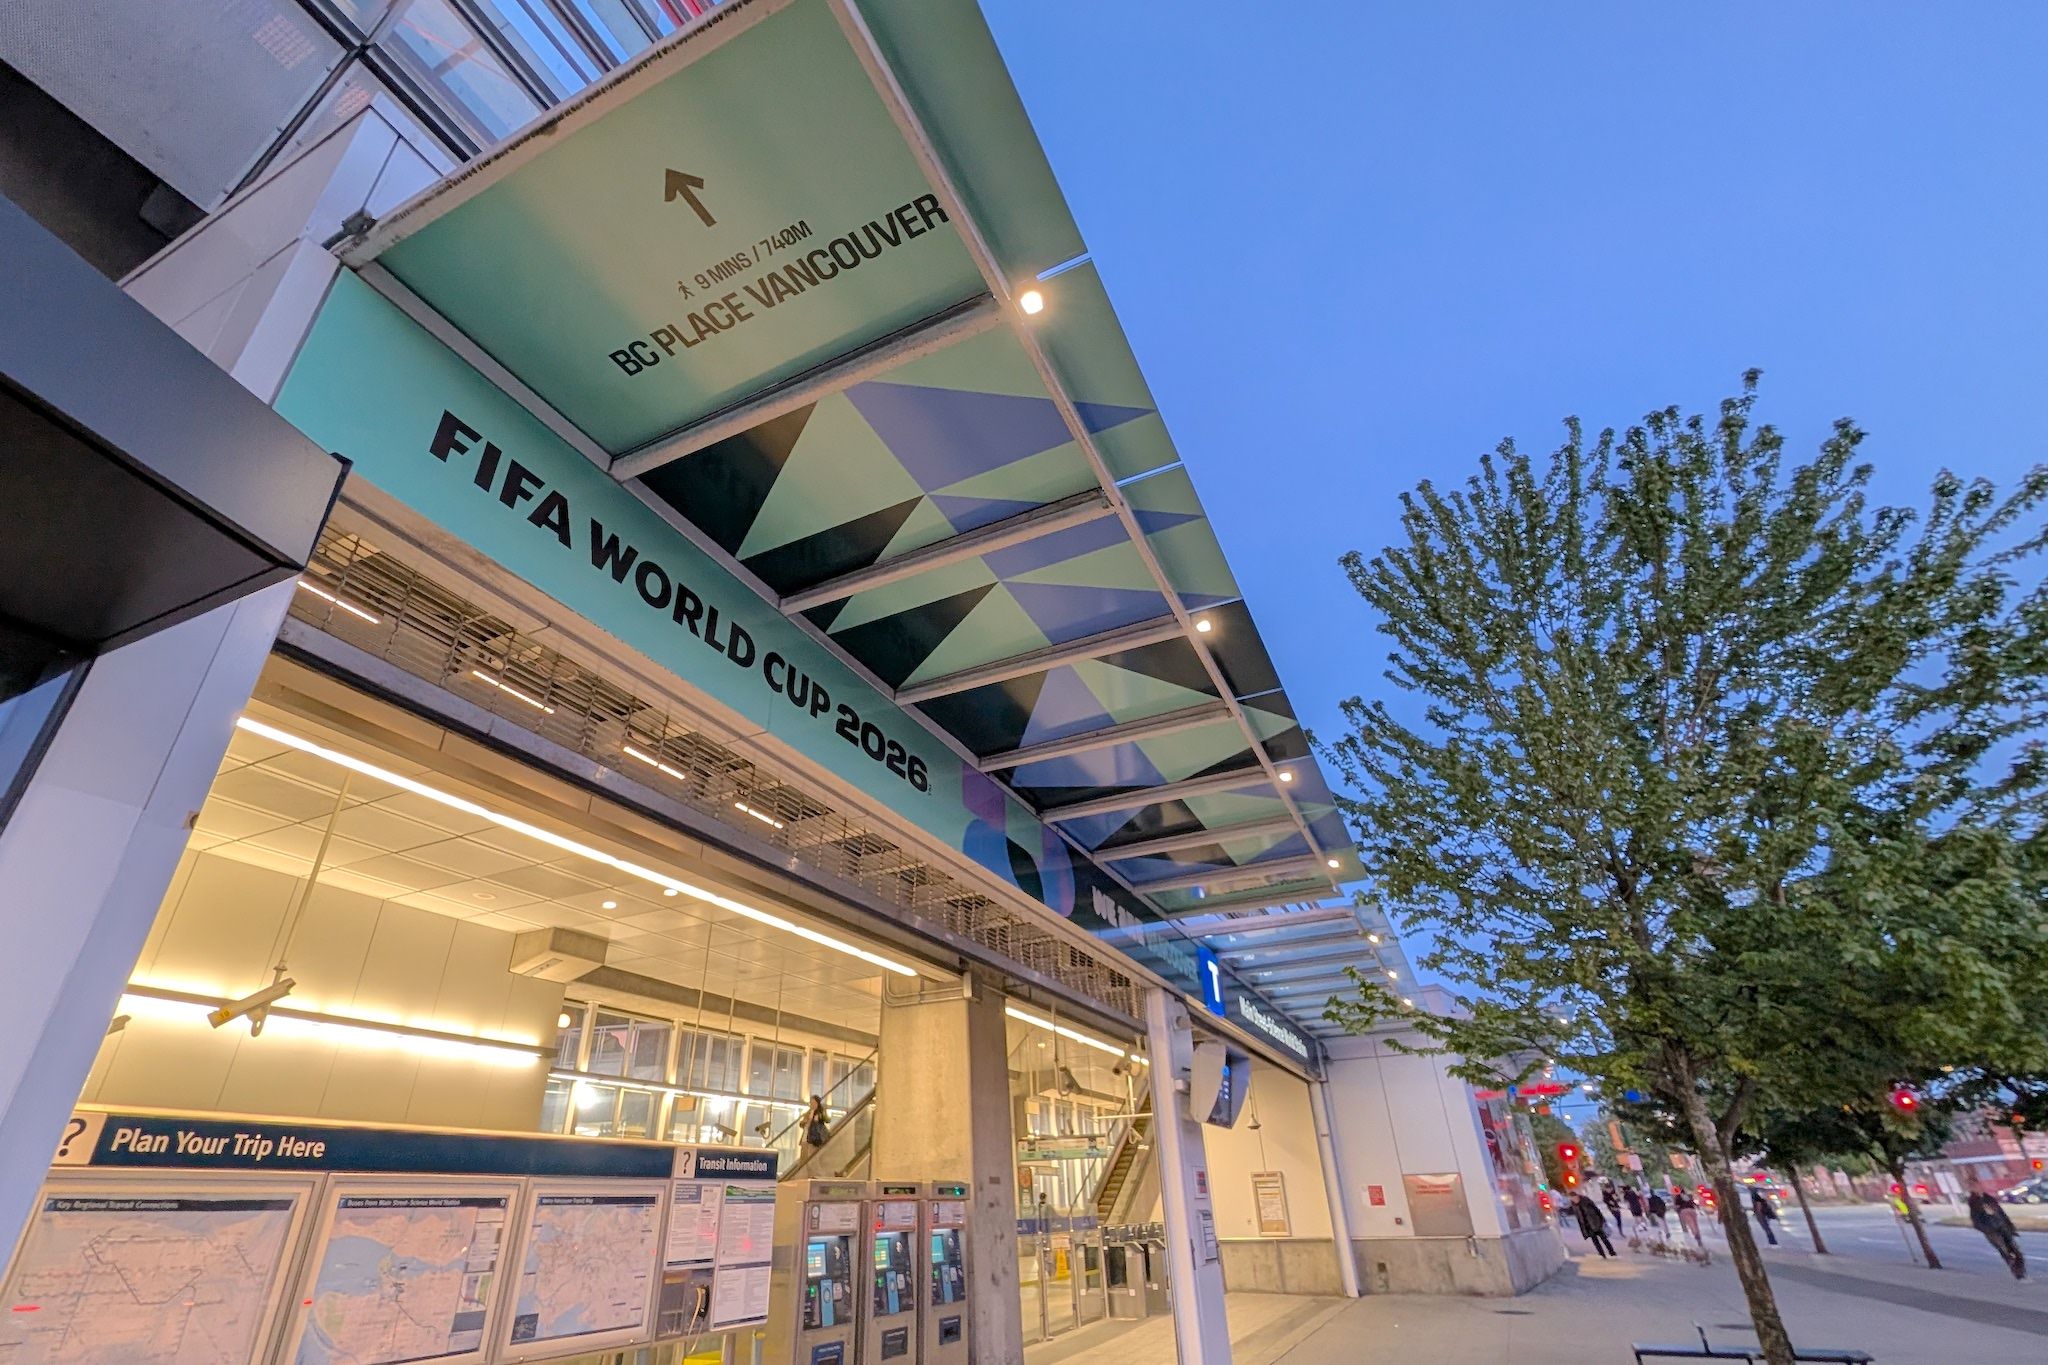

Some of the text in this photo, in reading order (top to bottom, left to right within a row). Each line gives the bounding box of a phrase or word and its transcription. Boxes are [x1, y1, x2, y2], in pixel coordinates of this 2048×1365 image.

[608, 193, 949, 377] BC PLACE VANCOUVER
[694, 220, 813, 289] 9 MINS / 740M
[429, 409, 928, 792] FIFA WORLD CUP 2026
[111, 1128, 326, 1161] Plan Your Trip Here
[699, 1157, 768, 1172] Transit Information
